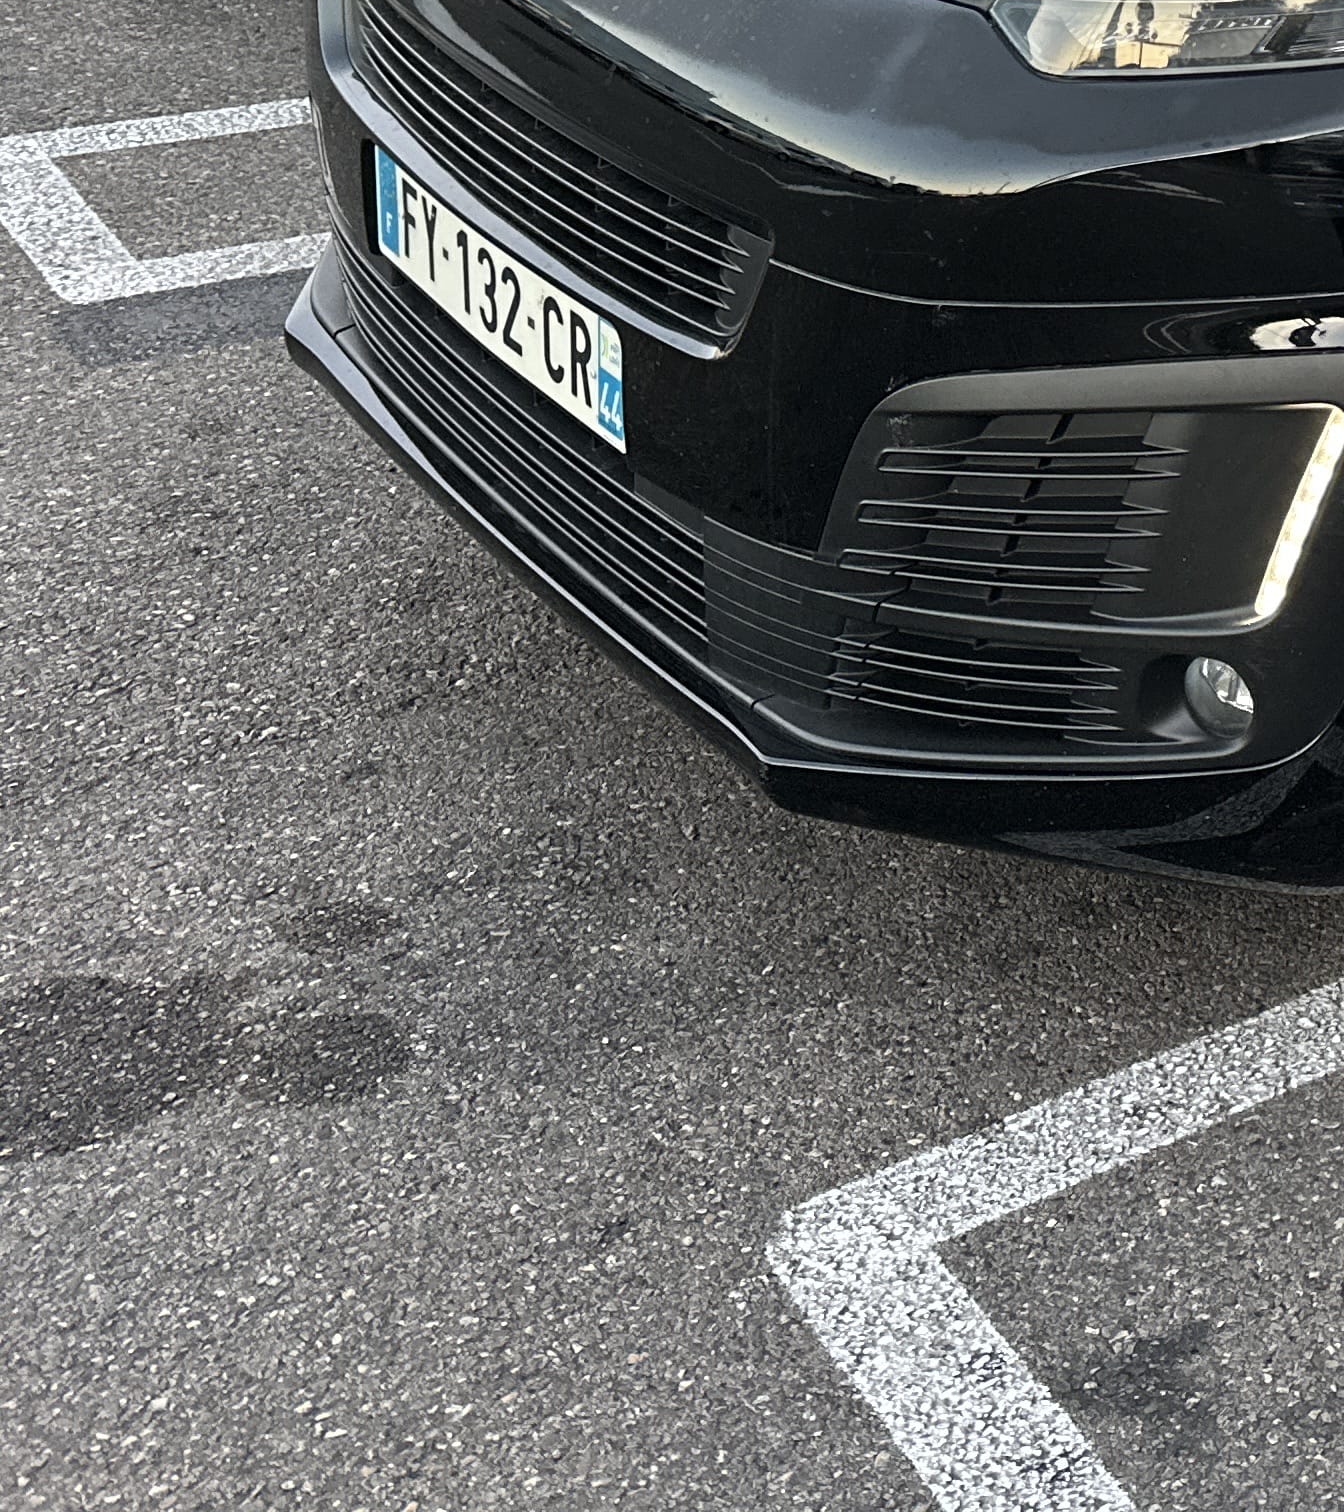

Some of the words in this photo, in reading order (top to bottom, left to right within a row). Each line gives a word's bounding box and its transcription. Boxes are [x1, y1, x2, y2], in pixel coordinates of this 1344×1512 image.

[385, 211, 393, 235] F
[402, 177, 593, 409] FY-132-CR
[600, 381, 623, 431] 44
